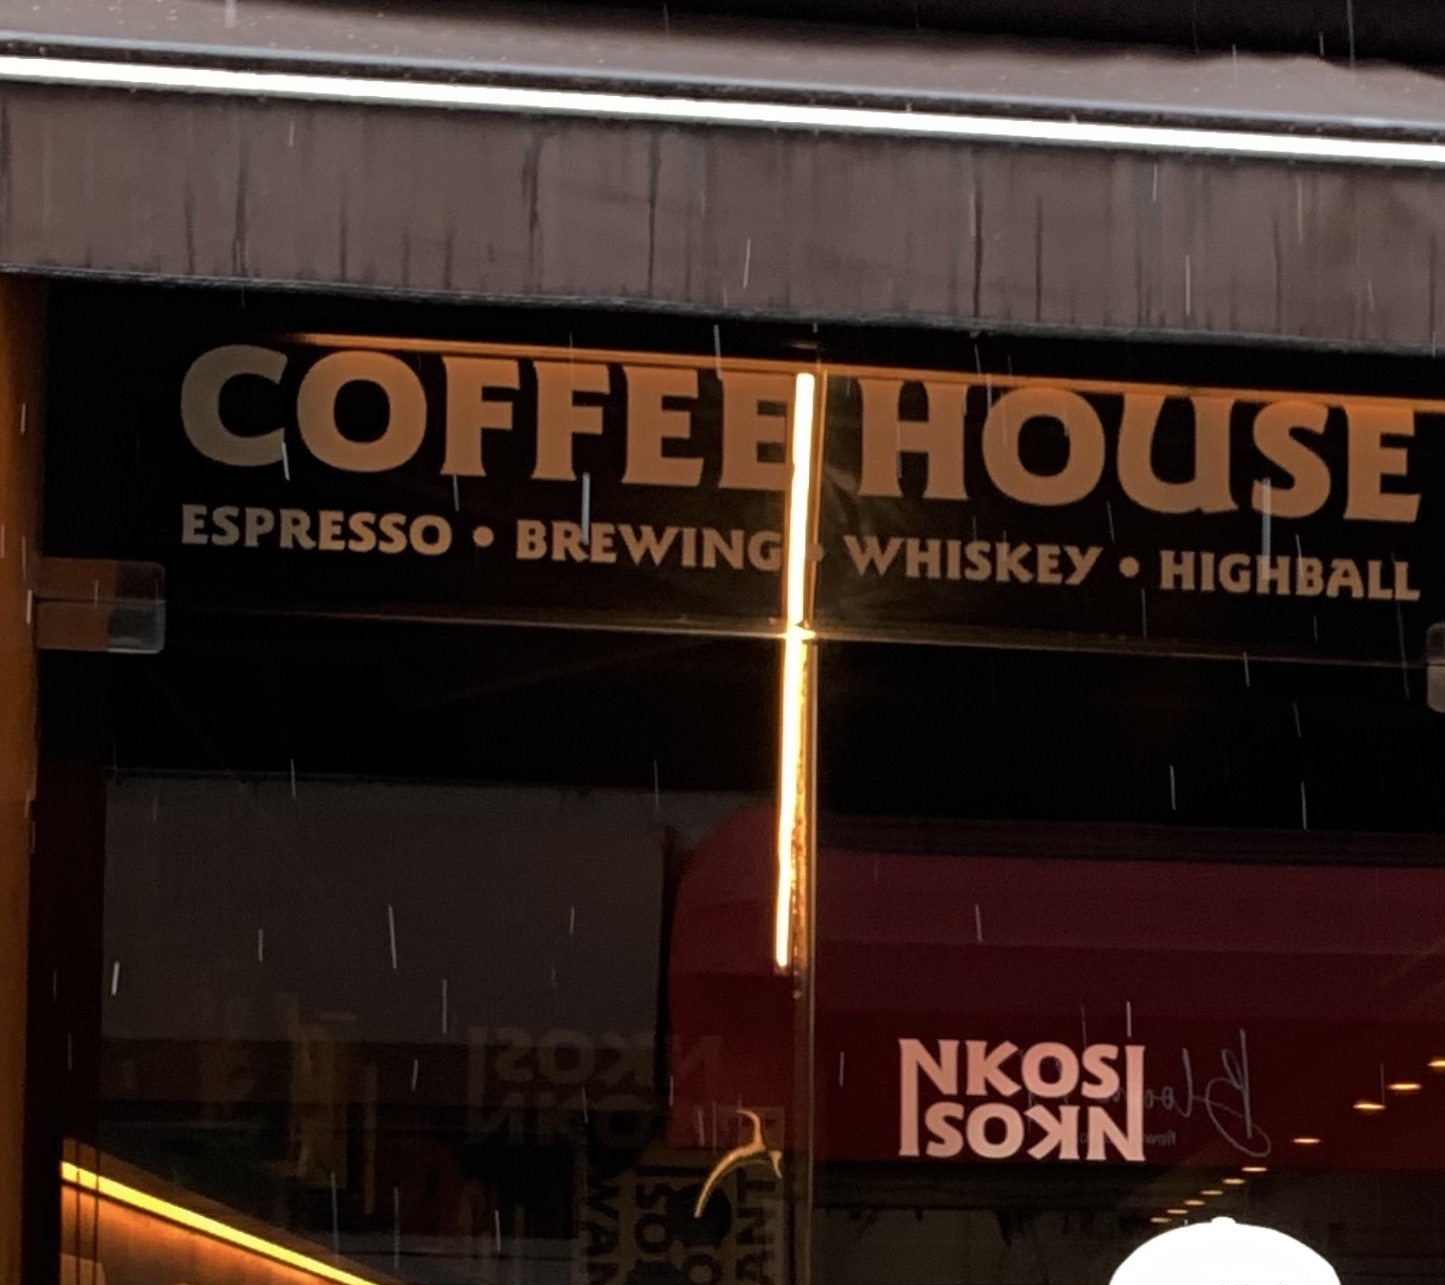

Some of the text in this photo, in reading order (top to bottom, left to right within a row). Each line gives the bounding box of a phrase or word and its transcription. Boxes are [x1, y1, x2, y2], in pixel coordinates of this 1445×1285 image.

[181, 344, 1421, 523] COFFEE HOUSE
[181, 504, 1421, 601] ESPRESSO BREWING WHISKEY HIGHBALL
[898, 1037, 1146, 1098] NKOSI
